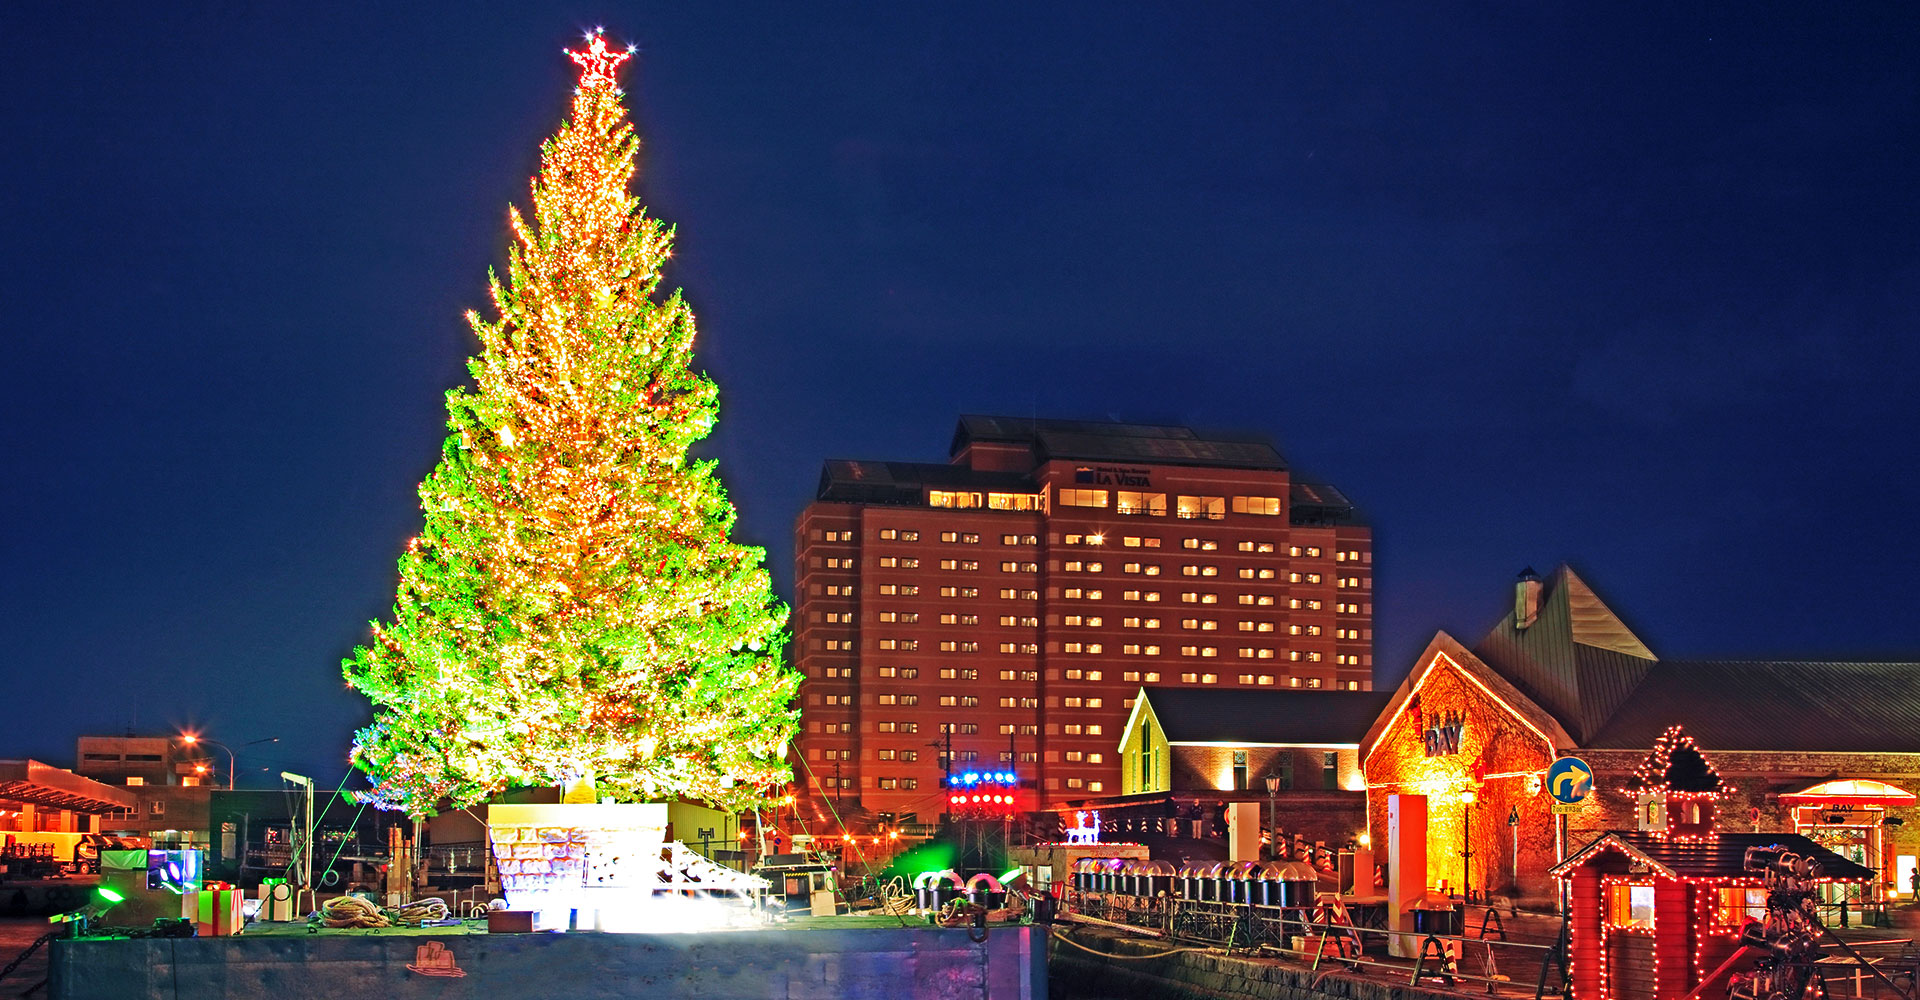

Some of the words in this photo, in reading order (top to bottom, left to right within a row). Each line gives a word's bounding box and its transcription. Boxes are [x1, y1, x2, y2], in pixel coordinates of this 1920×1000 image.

[1096, 472, 1113, 485] LA
[1115, 473, 1151, 487] VISTA
[1425, 725, 1462, 758] BAY
[1832, 804, 1855, 813] BAY
